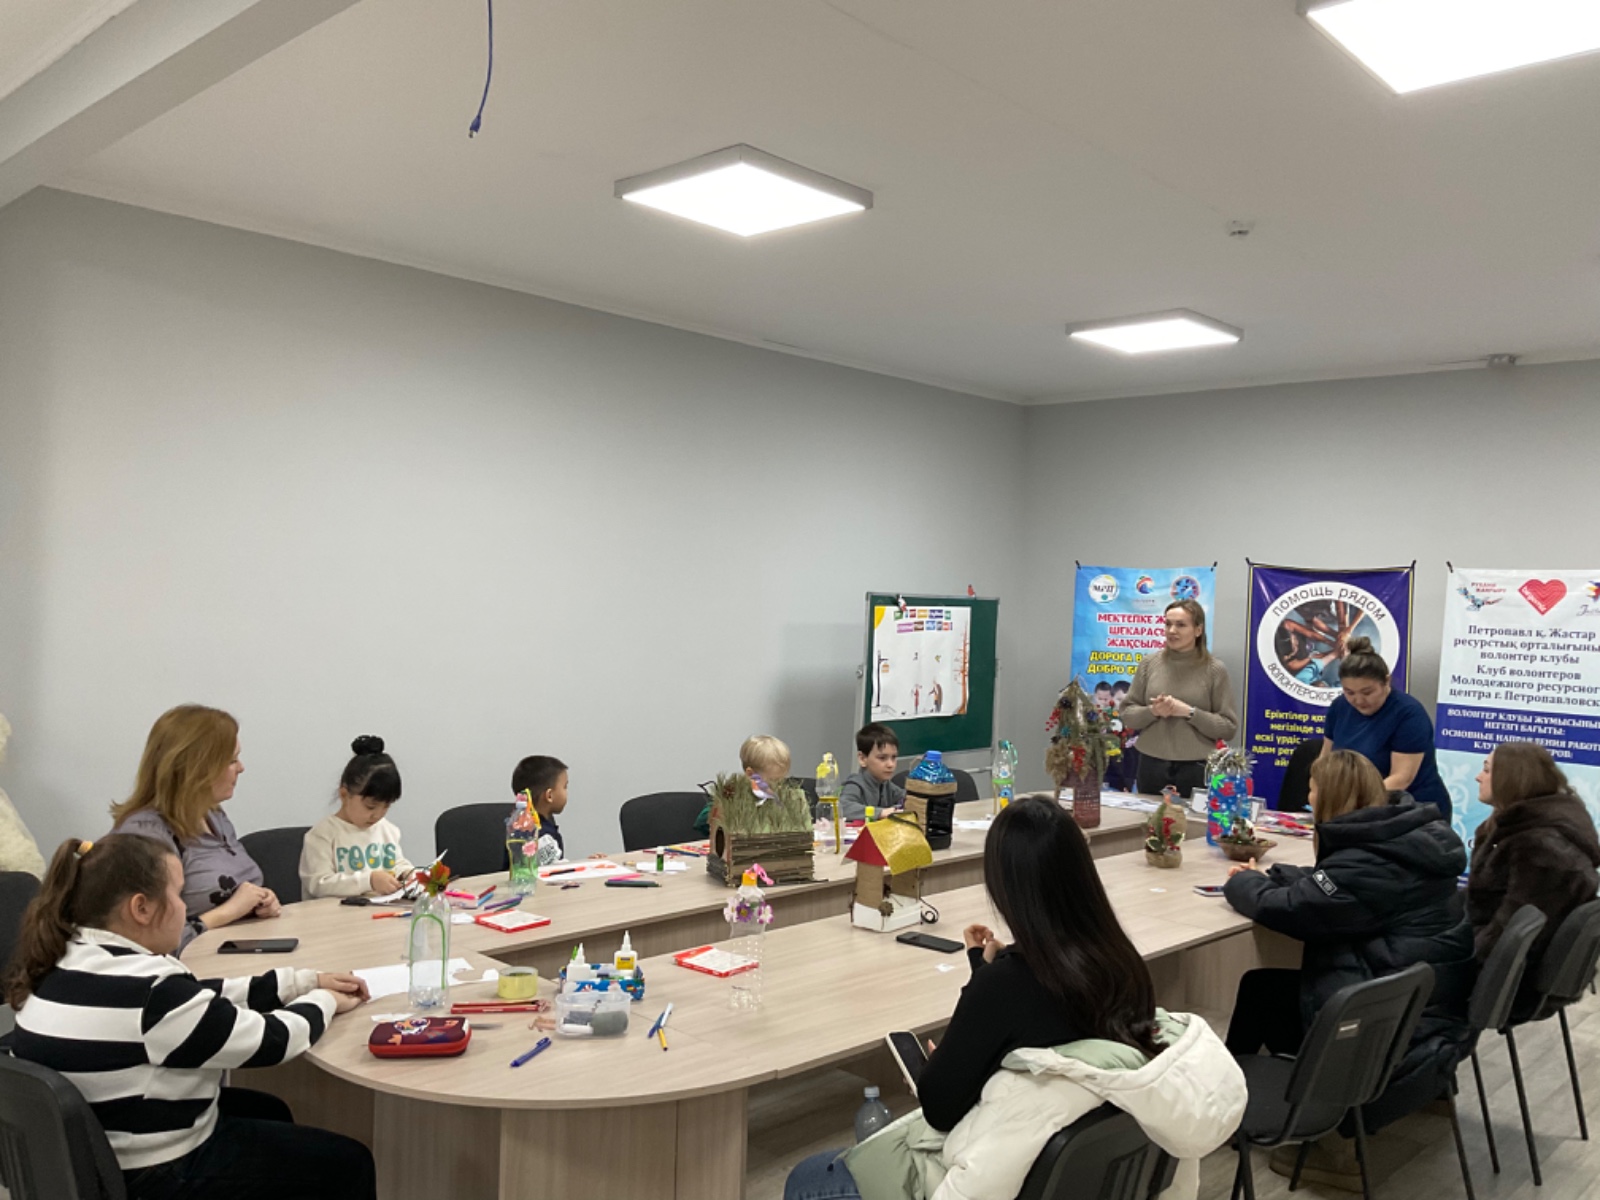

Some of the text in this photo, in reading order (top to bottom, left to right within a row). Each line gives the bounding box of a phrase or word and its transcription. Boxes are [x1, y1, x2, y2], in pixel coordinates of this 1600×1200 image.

[1097, 613, 1153, 624] МЕКТЕПКЕ
[1468, 625, 1533, 637] Петропавл
[1549, 628, 1596, 641] Жастар
[1454, 637, 1518, 650] ресурстық
[1090, 651, 1133, 662] ДОРОГА
[1480, 651, 1580, 665] волонтер клубы
[1087, 664, 1125, 674] ДОБРО
[1477, 665, 1582, 681] Клуб волонтеров
[1450, 675, 1600, 695] Молодежного ресурсног
[1449, 688, 1491, 700] центра
[1504, 690, 1600, 707] Петропавловск
[1447, 708, 1497, 720] ВОЛОНТЕР
[1499, 713, 1533, 723] КЛУБЫ
[1441, 728, 1494, 741] ОСНОВНЫЕ
